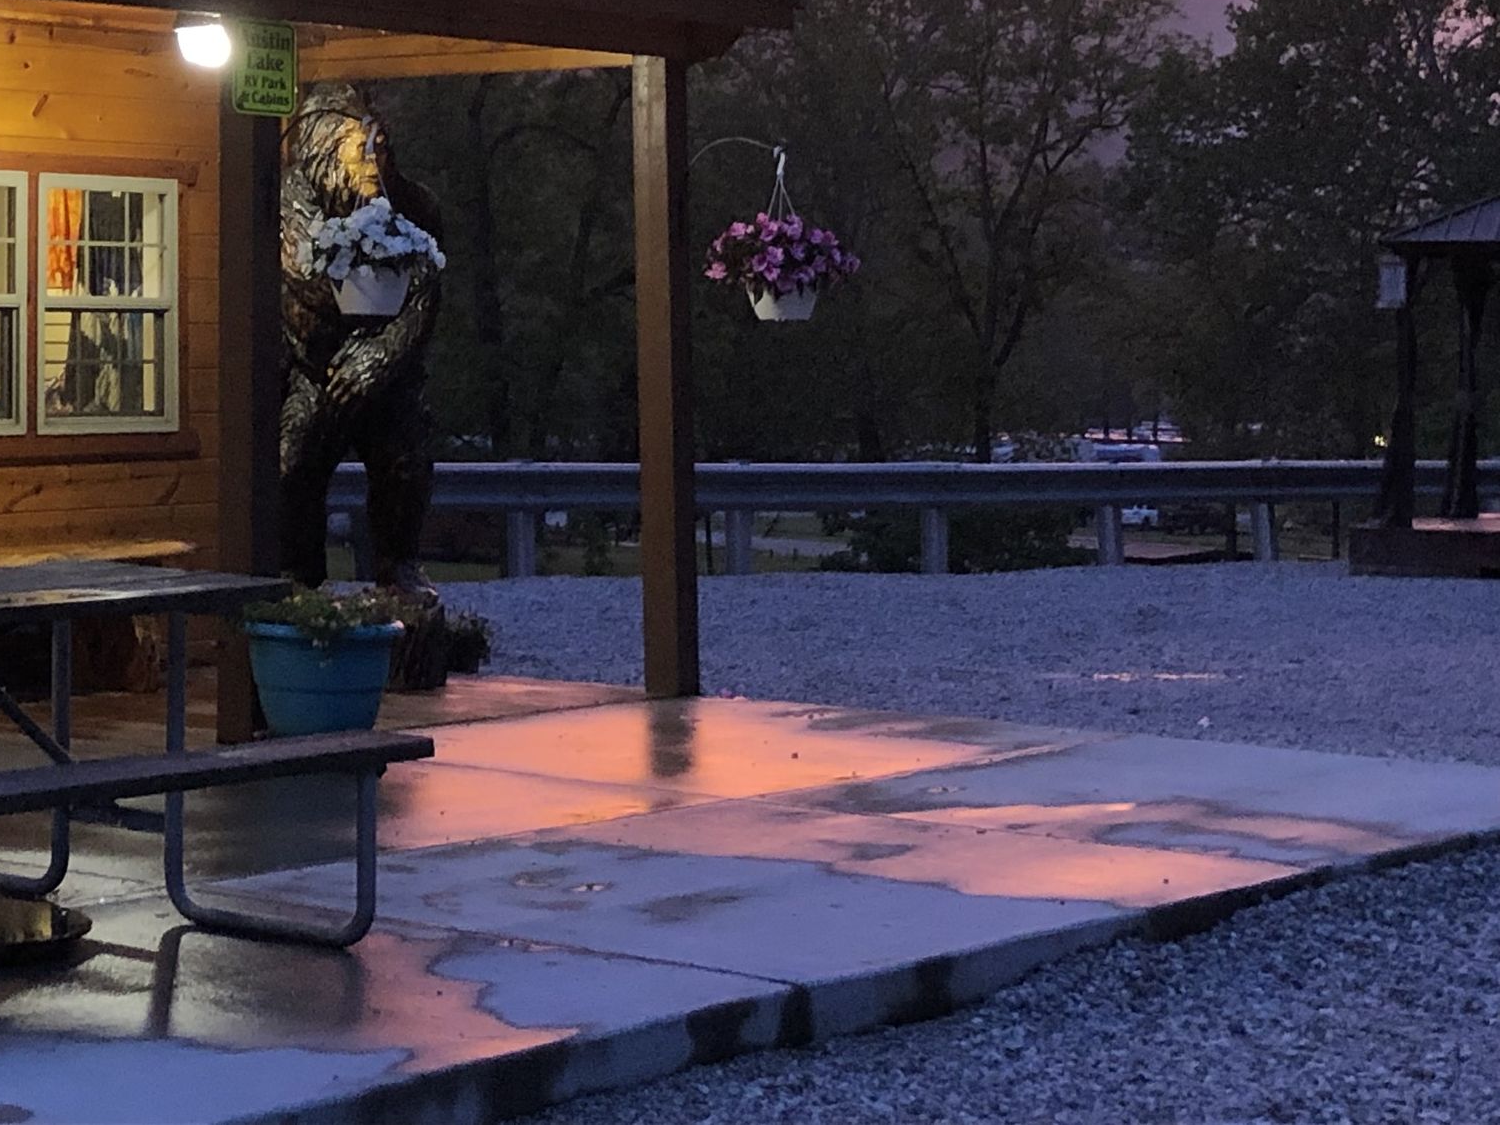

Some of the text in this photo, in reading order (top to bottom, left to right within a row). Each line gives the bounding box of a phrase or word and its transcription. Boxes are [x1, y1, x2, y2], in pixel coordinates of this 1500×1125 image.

[247, 53, 284, 72] Lake
[244, 75, 286, 91] RV Park
[251, 91, 290, 106] Cabins
